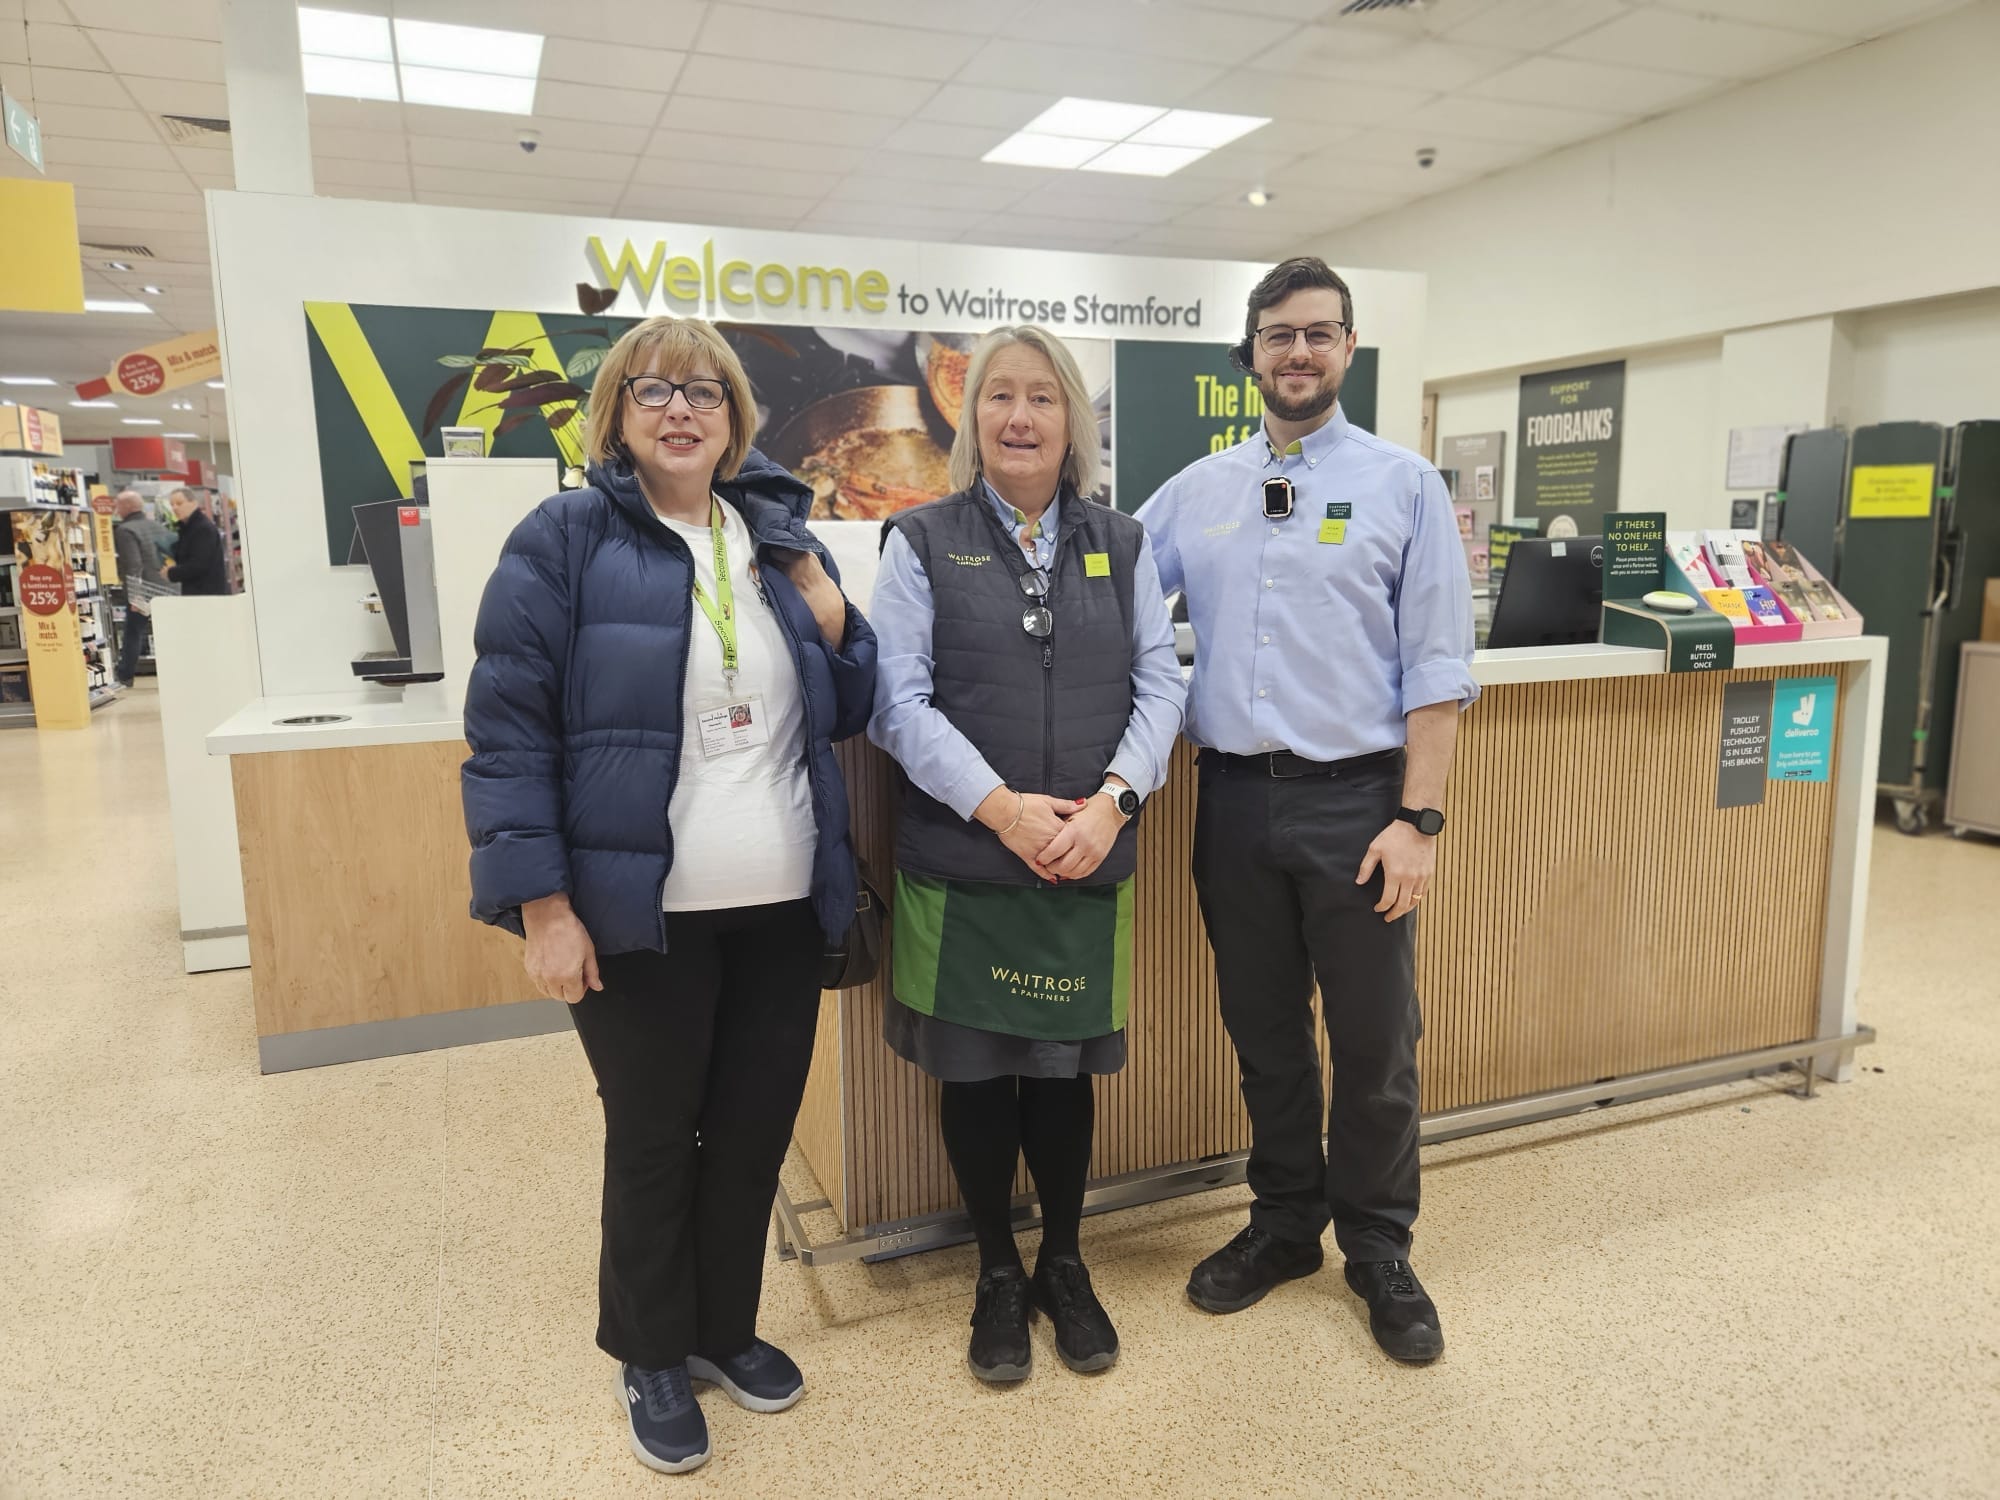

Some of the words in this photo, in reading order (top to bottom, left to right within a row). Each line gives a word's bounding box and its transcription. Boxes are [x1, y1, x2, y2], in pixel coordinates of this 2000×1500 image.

[587, 236, 890, 312] Welcome
[897, 284, 929, 315] to
[936, 288, 1067, 323] Waitrose
[1073, 294, 1202, 328] Stamford
[129, 372, 161, 390] 25%
[1550, 380, 1591, 396] SUPPORT
[1195, 375, 1238, 418] The
[1560, 394, 1578, 405] FOR
[1527, 407, 1613, 447] FOODBANKS
[1616, 521, 1623, 529] IF
[1624, 521, 1656, 529] THERE'S
[1608, 532, 1622, 541] NO
[1623, 532, 1641, 541] ONE
[1642, 531, 1663, 540] HERE
[1616, 543, 1628, 552] TO
[947, 552, 991, 563] WAITROSE
[716, 556, 727, 582] Second
[29, 574, 41, 583] Buy
[29, 591, 59, 606] 25%
[1759, 599, 1776, 611] HIP
[38, 621, 48, 631] Mix
[50, 621, 57, 631] &
[39, 632, 58, 640] match
[714, 620, 735, 652] Second
[1695, 643, 1713, 652] PRESS
[1690, 652, 1717, 661] BUTTON
[1693, 661, 1713, 669] ONCE
[1732, 715, 1760, 725] TROLLEY
[1730, 725, 1761, 736] PUSHOUT
[1784, 728, 1820, 738] deliveroo
[1722, 735, 1767, 747] TECHNOLOGY
[1725, 749, 1731, 757] IS
[1732, 748, 1740, 757] IN
[1740, 747, 1753, 756] USE
[1753, 746, 1762, 755] AT
[1720, 759, 1736, 768] THIS
[991, 966, 1086, 992] WAITROSE
[1020, 989, 1071, 1002] PARTNERS
